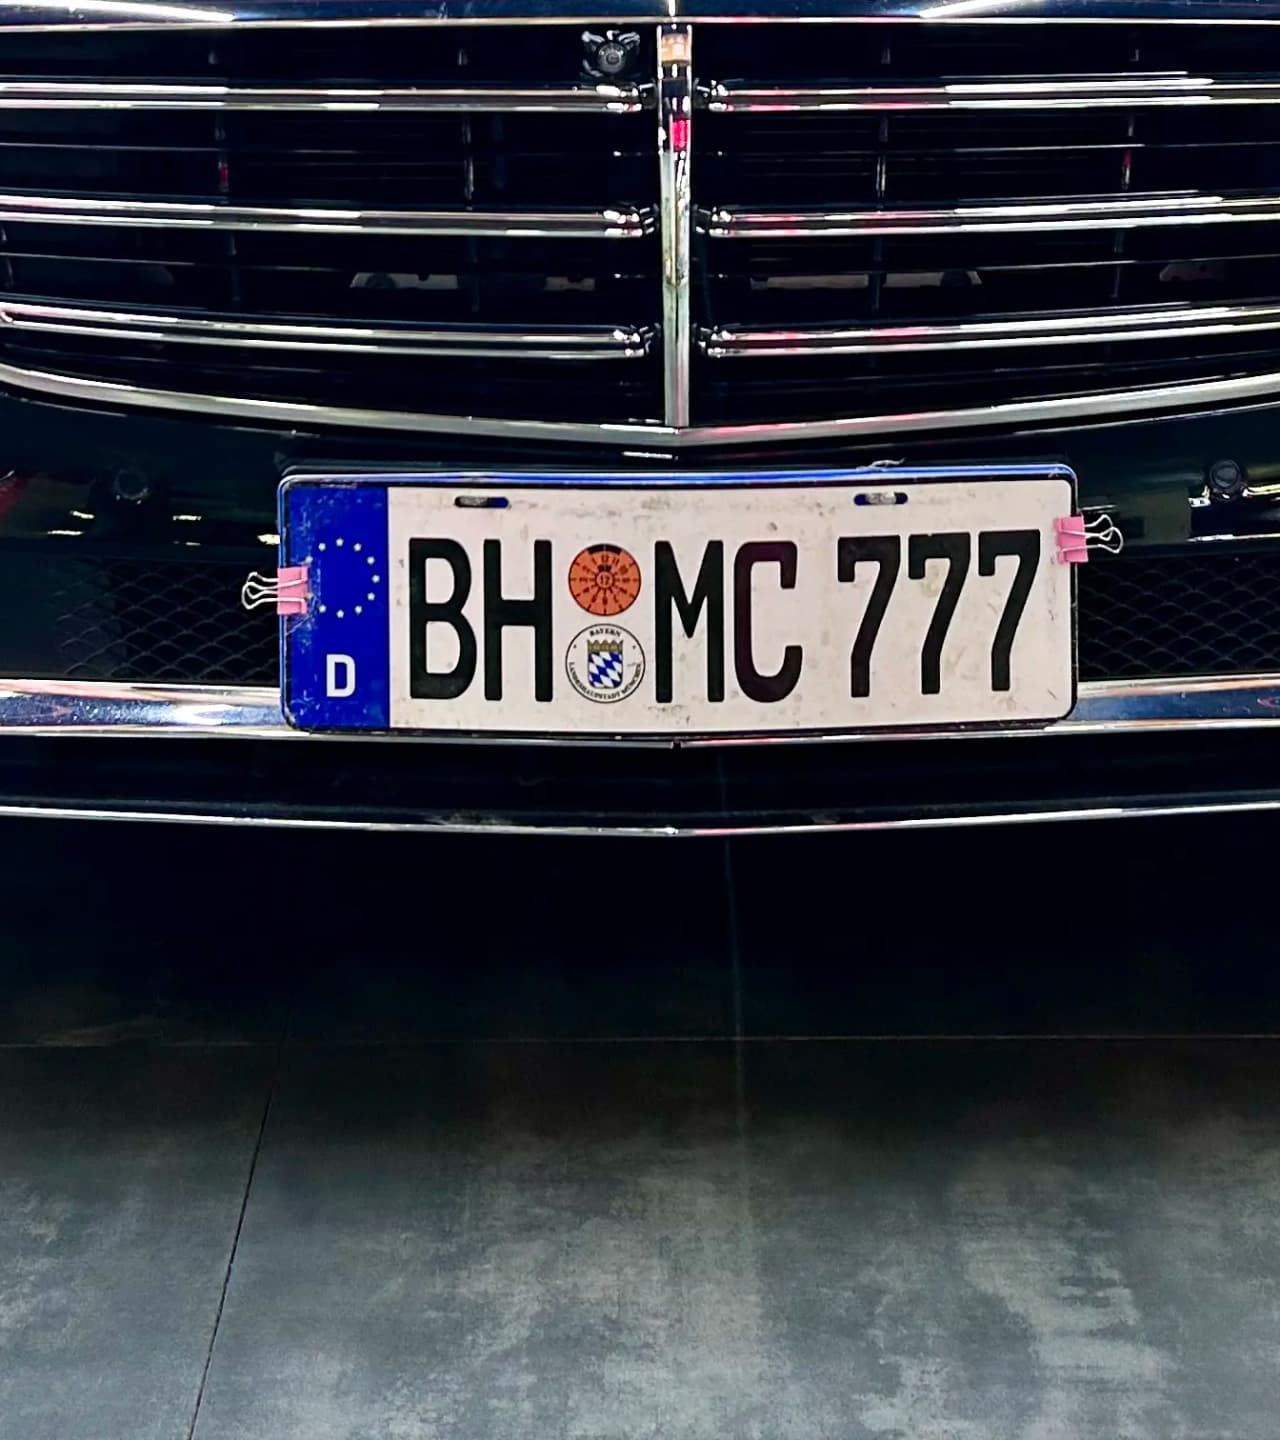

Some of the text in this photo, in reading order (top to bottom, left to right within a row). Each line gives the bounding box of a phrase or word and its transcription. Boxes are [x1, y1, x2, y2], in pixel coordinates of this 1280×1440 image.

[409, 529, 1041, 703] BH MC 777
[589, 627, 621, 638] BAYERN
[326, 654, 356, 697] D
